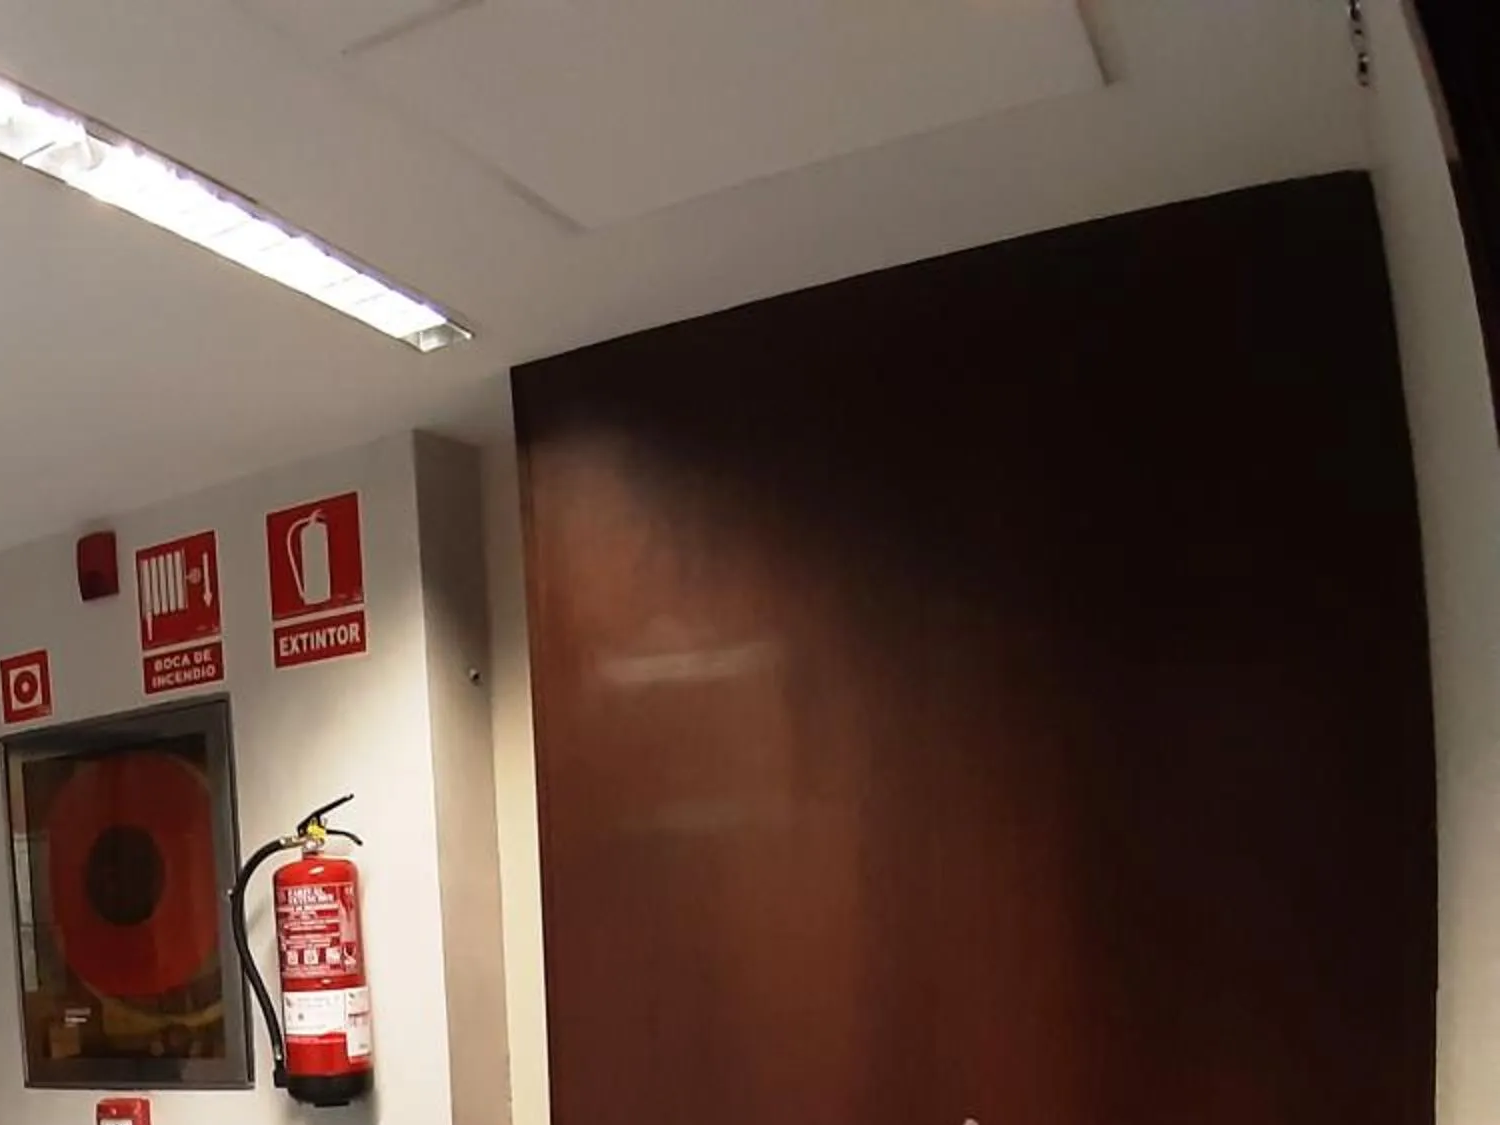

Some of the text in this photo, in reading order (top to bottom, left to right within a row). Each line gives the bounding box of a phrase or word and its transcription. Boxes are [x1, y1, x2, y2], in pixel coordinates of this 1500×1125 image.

[279, 622, 361, 657] EXTINTOR
[154, 648, 213, 672] BOCA DE
[152, 663, 217, 688] INCENDIO
